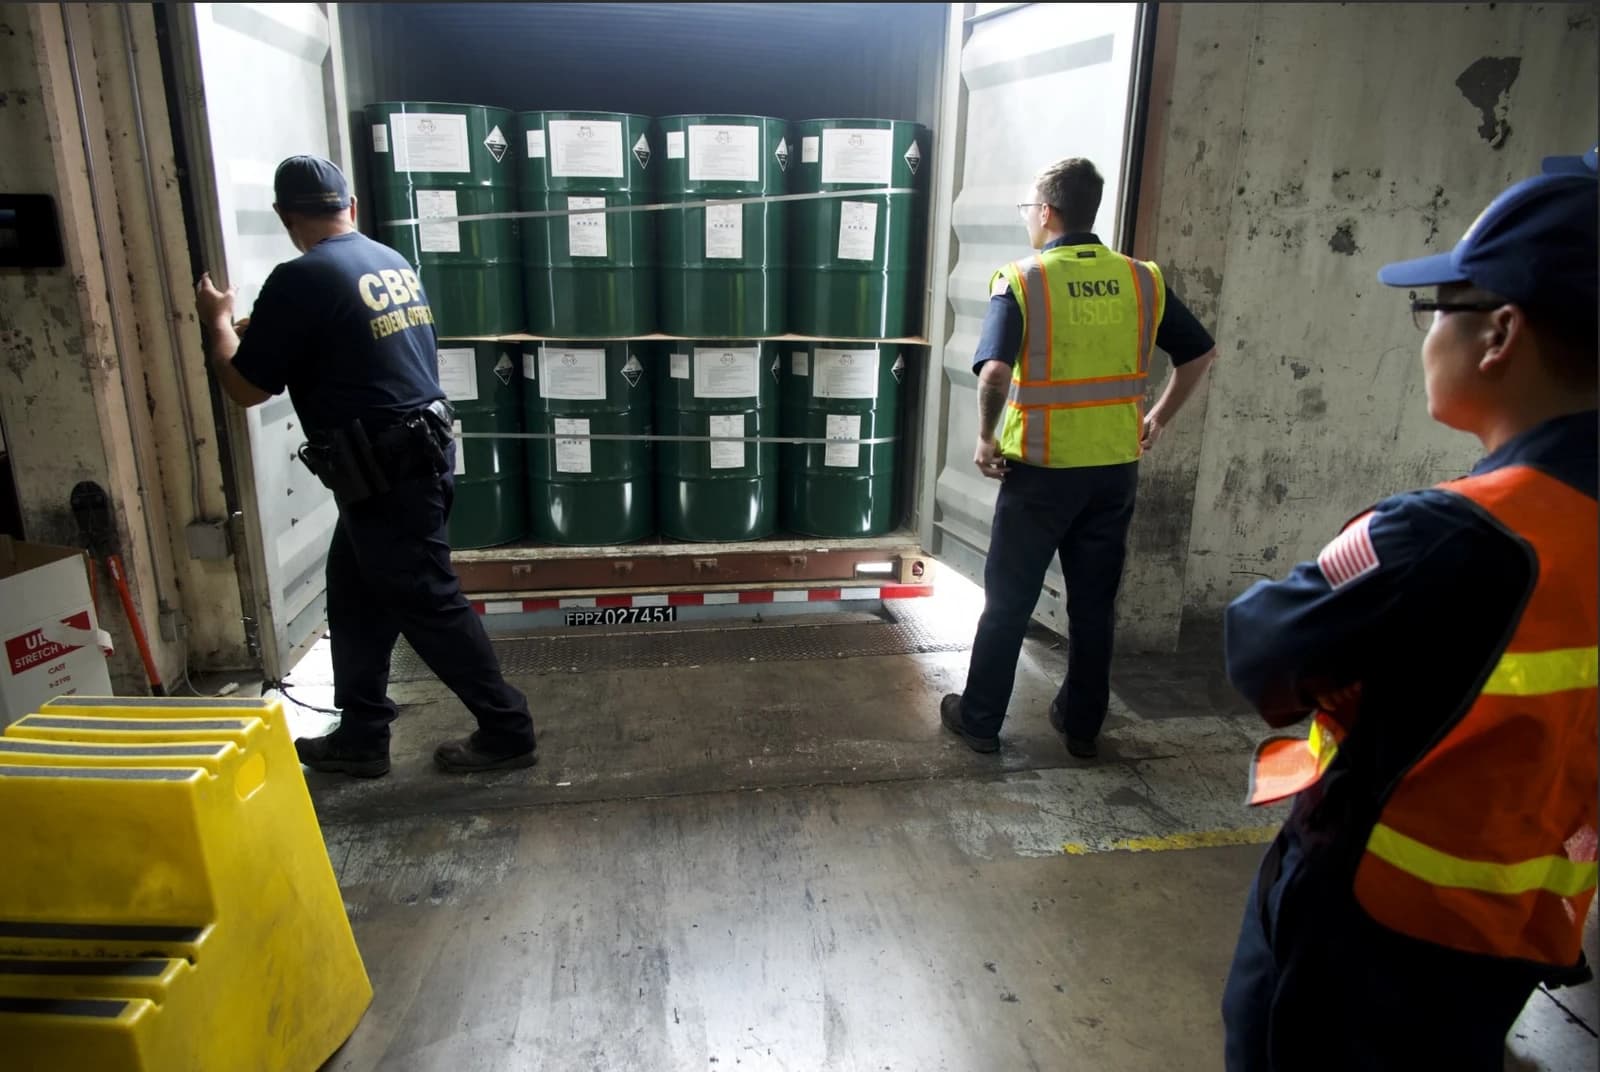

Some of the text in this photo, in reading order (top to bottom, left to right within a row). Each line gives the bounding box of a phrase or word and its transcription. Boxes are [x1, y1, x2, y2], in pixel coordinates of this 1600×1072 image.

[358, 268, 421, 311] CBP
[1067, 279, 1120, 298] USCG
[369, 308, 410, 339] FEDERL
[1068, 299, 1122, 325] USCG
[25, 633, 48, 650] UL
[15, 643, 58, 669] STRETCH
